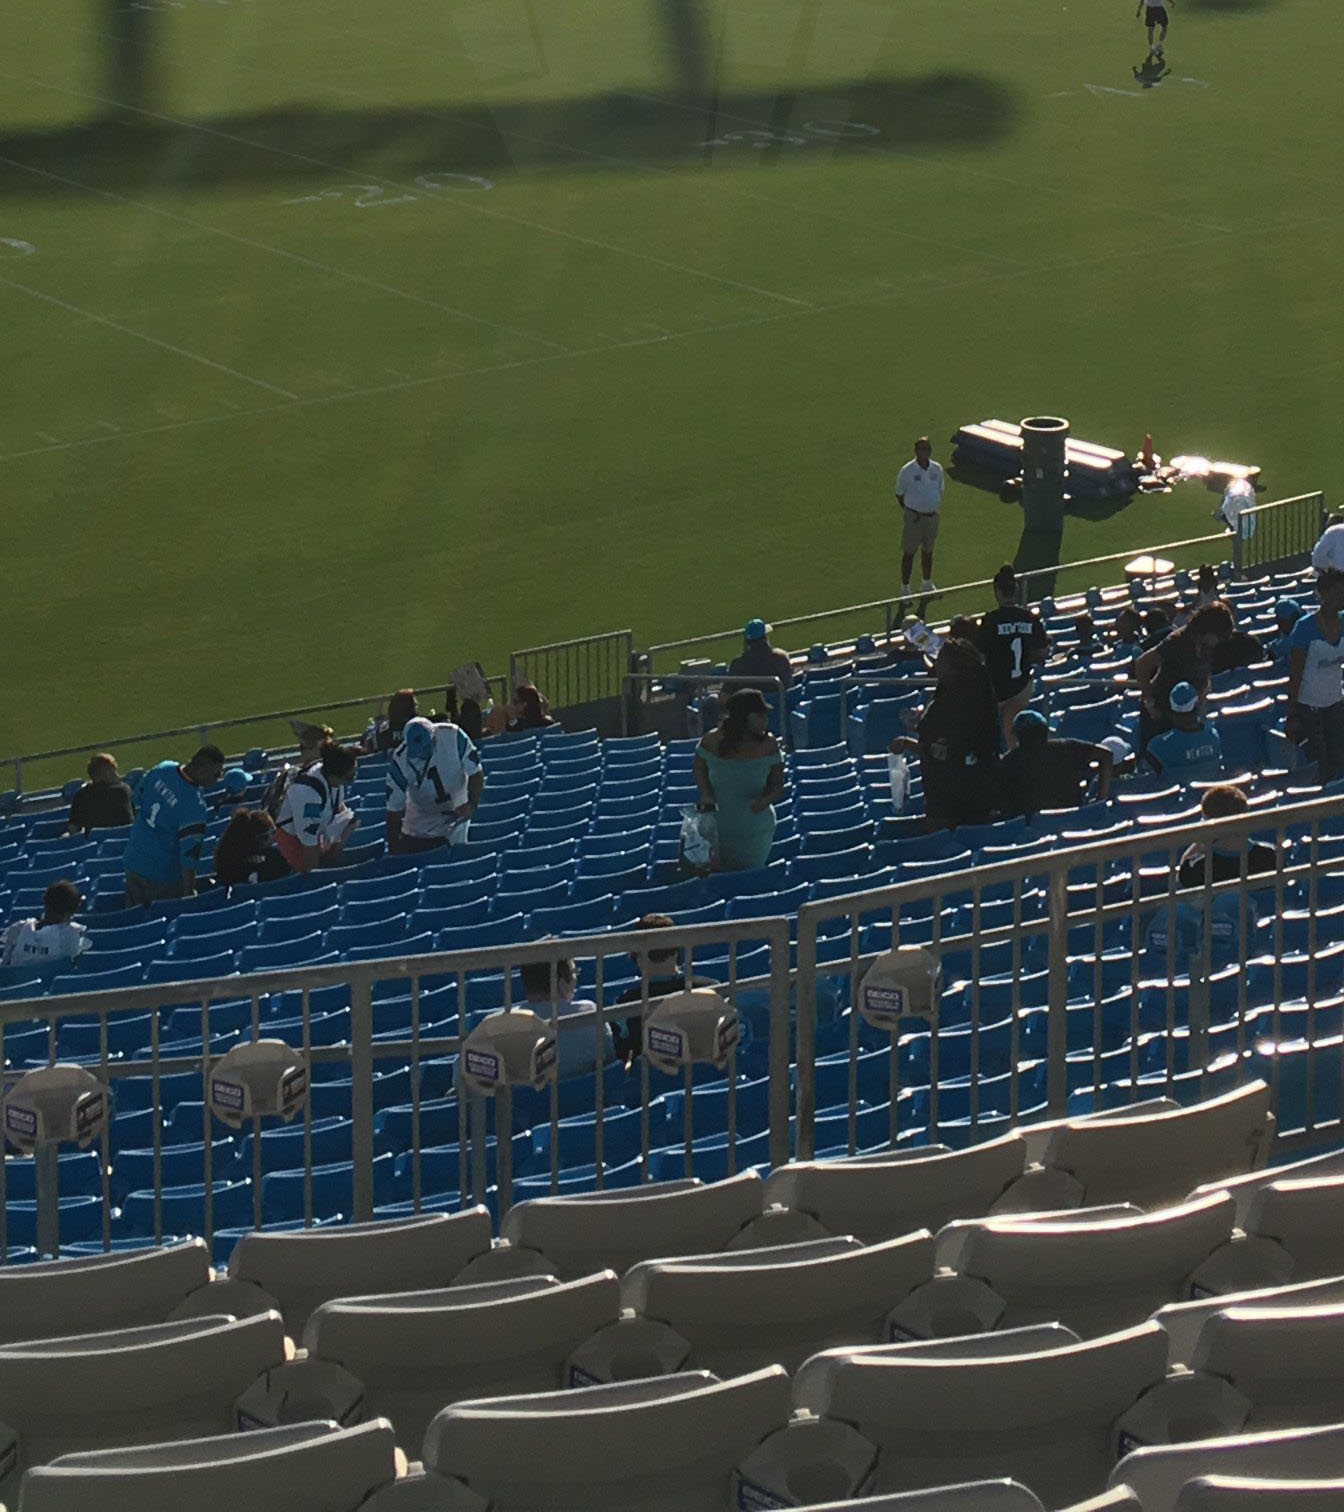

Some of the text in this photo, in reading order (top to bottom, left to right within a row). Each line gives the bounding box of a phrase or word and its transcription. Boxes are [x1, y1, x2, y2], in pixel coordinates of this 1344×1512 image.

[1010, 637, 1023, 678] 1
[427, 765, 452, 804] 1
[146, 802, 161, 828] 1
